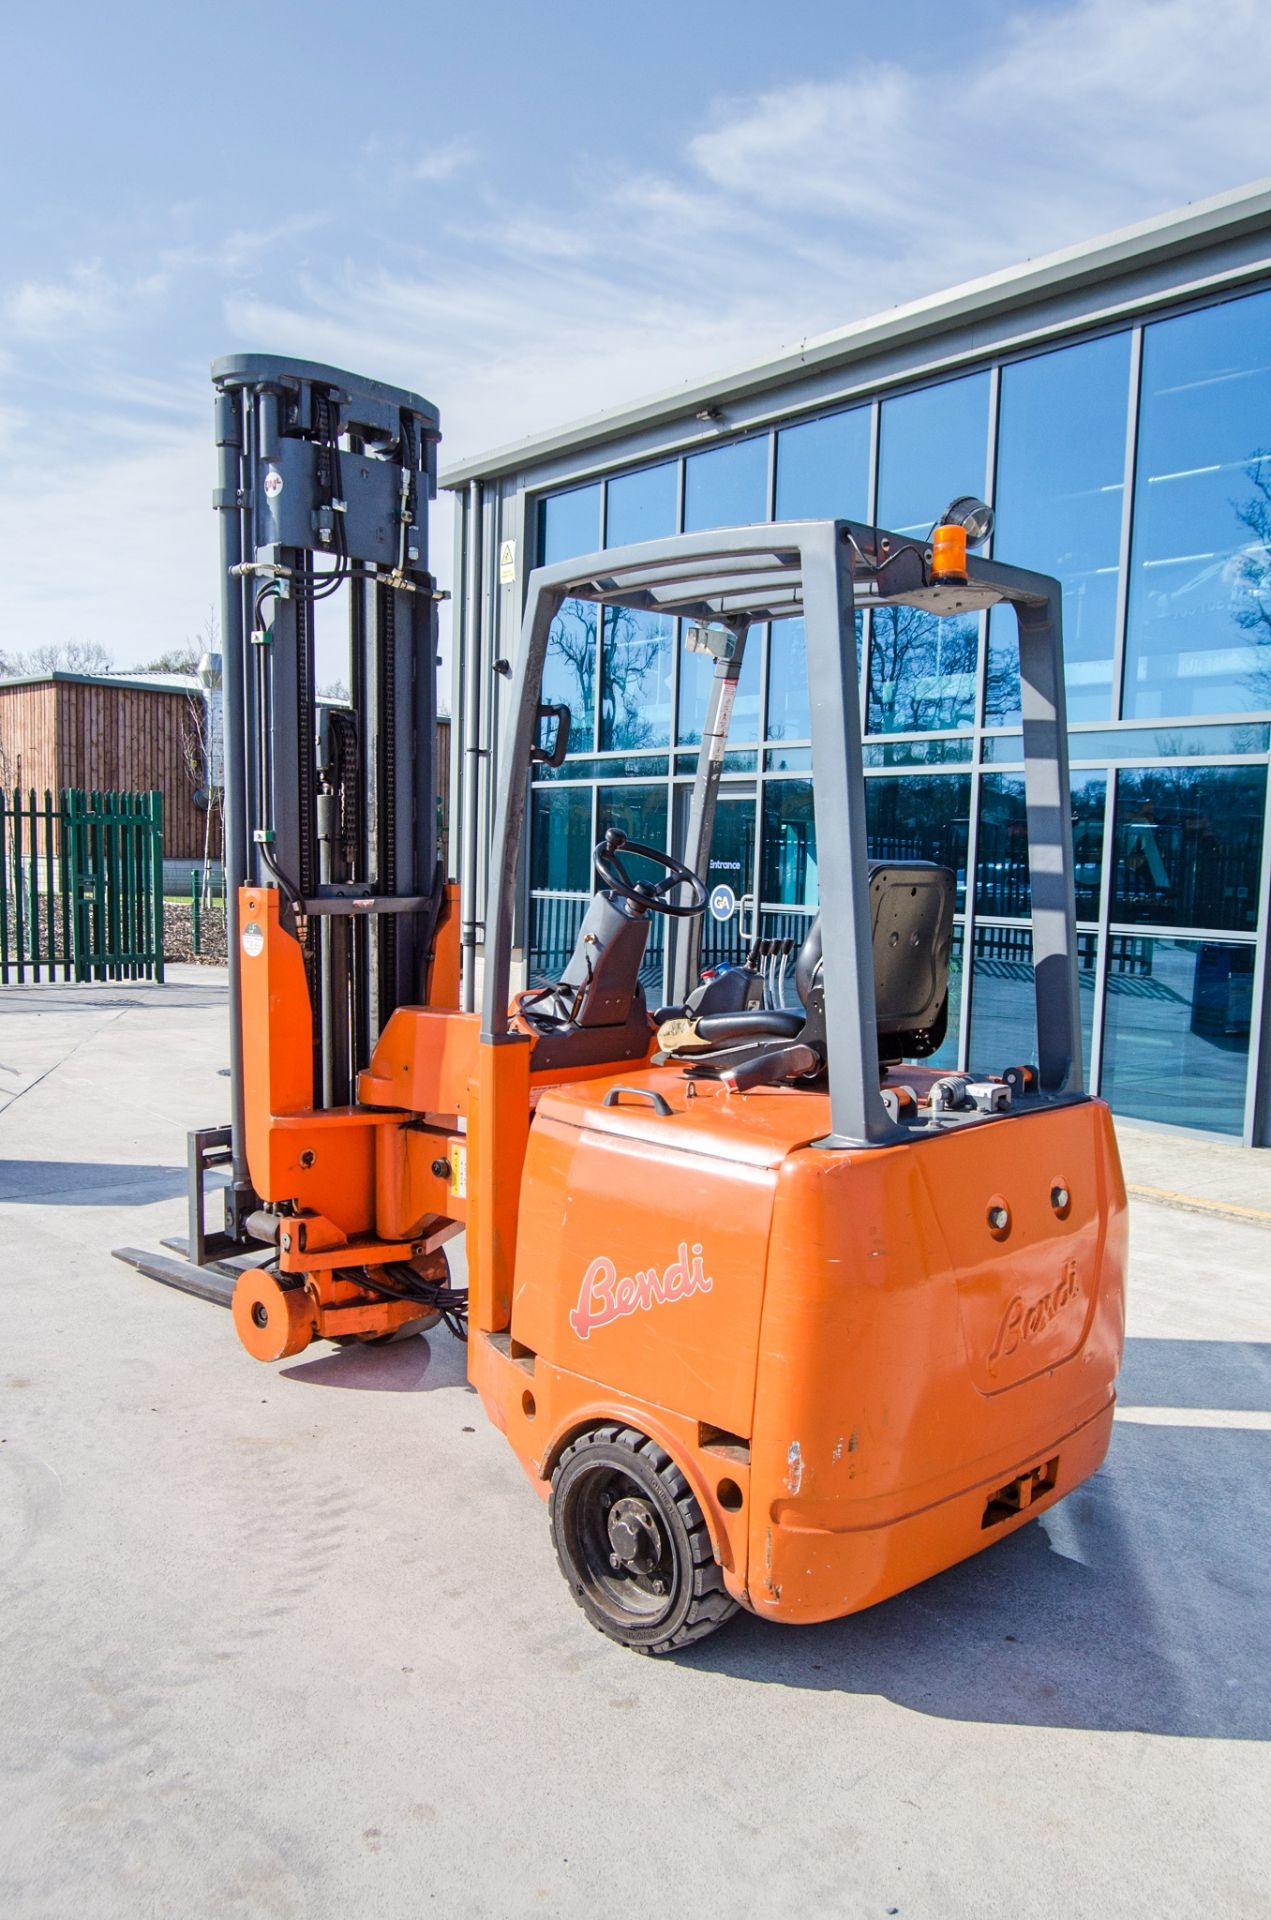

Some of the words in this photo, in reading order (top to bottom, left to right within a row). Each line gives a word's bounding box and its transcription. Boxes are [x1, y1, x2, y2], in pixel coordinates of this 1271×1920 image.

[710, 860, 741, 870] Entrance
[714, 896, 730, 910] GA
[569, 1242, 713, 1340] Bendi
[986, 1257, 1080, 1379] Bendi
